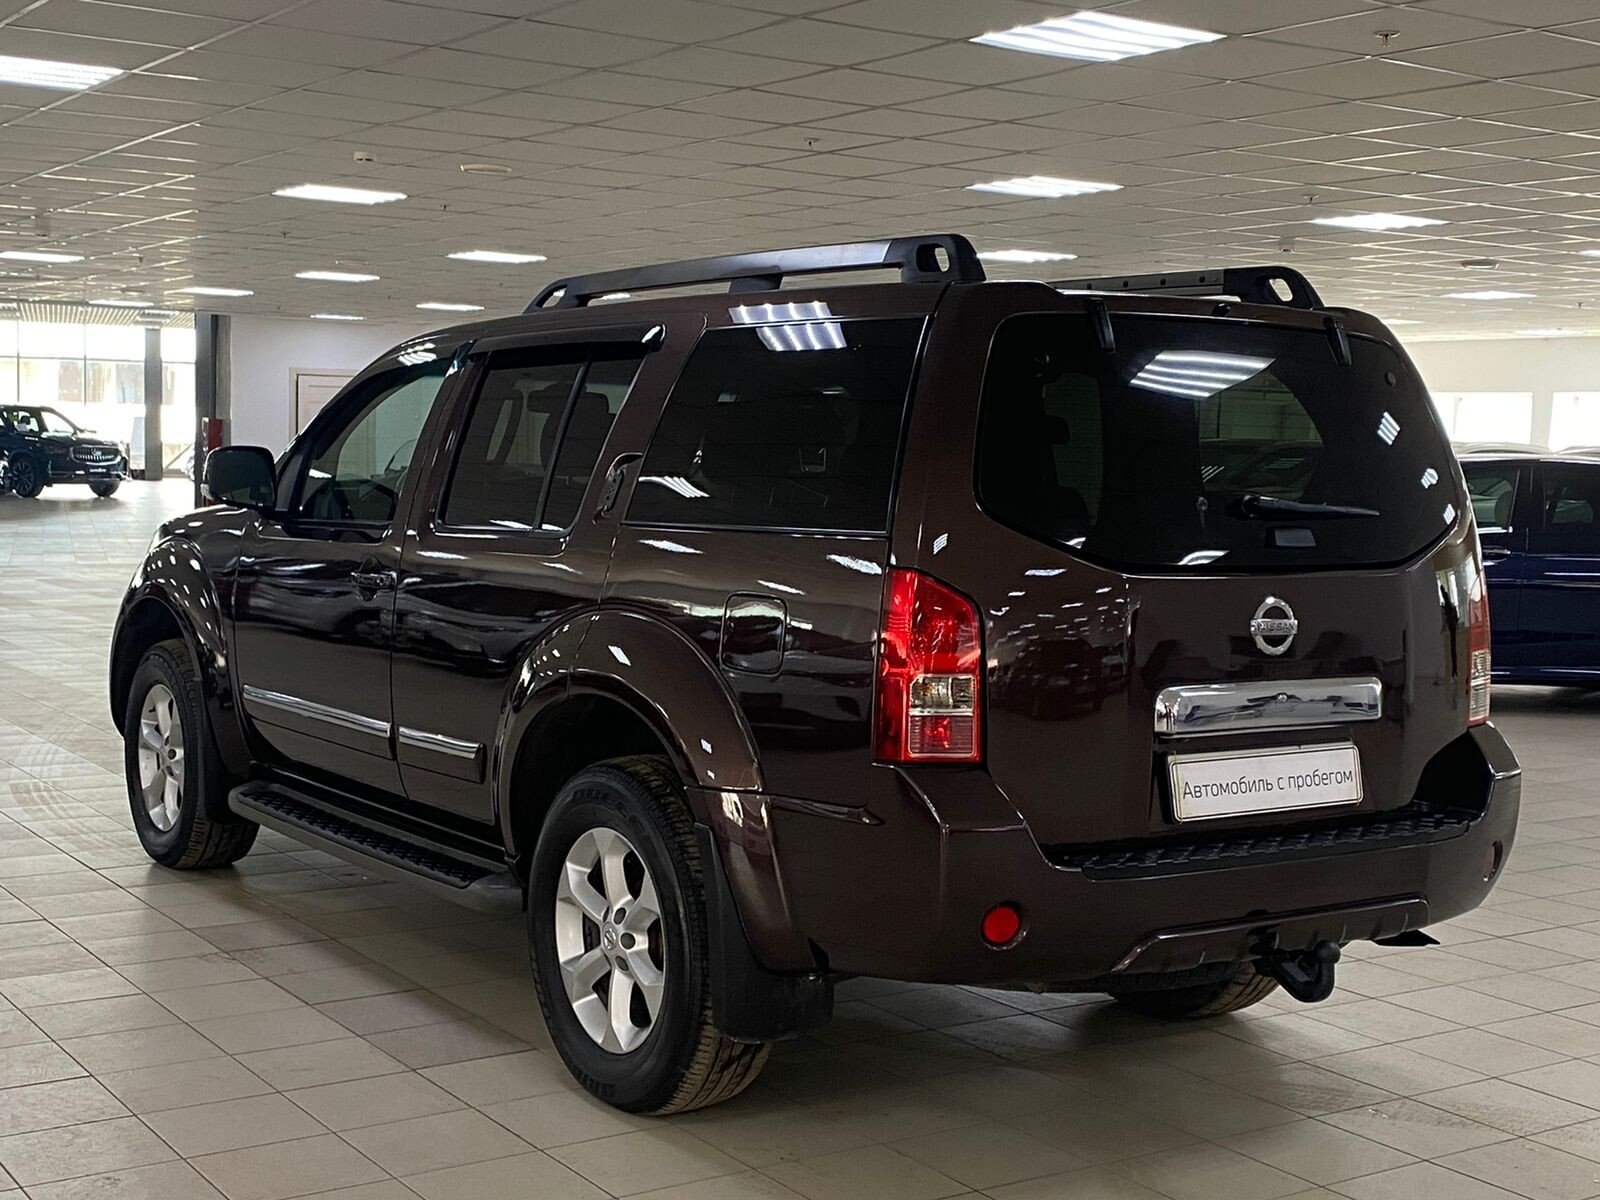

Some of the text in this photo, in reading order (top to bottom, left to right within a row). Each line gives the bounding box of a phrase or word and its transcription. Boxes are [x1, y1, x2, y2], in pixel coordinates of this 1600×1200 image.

[1256, 621, 1295, 633] NISSAN
[1182, 768, 1354, 800] Автомобиль с пробегом
